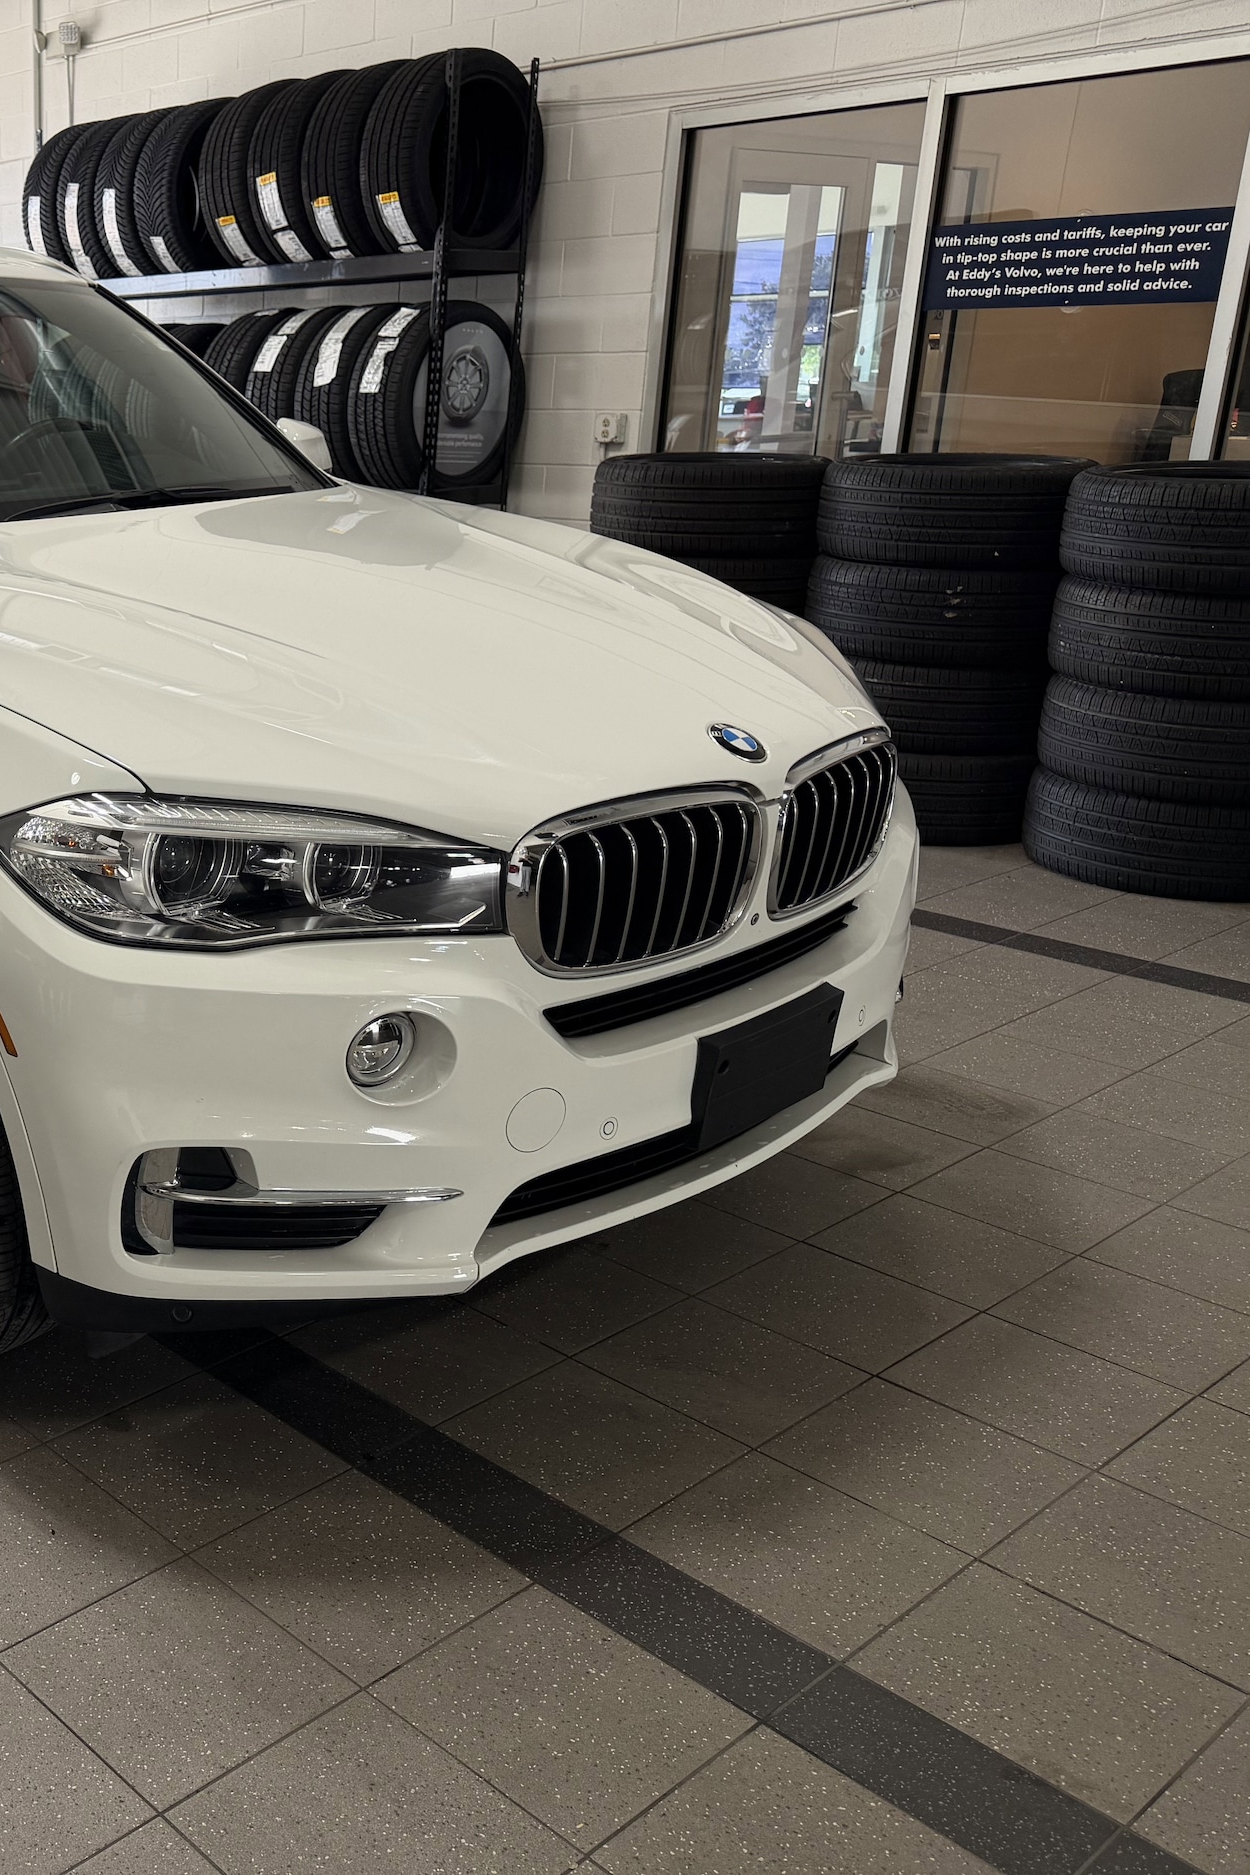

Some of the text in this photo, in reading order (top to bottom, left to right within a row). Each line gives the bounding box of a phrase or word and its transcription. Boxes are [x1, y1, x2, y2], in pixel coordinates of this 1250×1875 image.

[934, 221, 1229, 247] With rising costs and tariffs, keeping your car
[941, 241, 1211, 265] in tip-top shape is more crucial than ever.
[945, 270, 960, 280] At
[1004, 266, 1043, 278] Volvo,
[1045, 265, 1080, 276] we're
[1083, 263, 1114, 275] here
[1117, 263, 1131, 273] to
[1134, 260, 1165, 274] help
[1169, 258, 1200, 271] with
[946, 278, 1193, 298] thorough inspections and solid advice.
